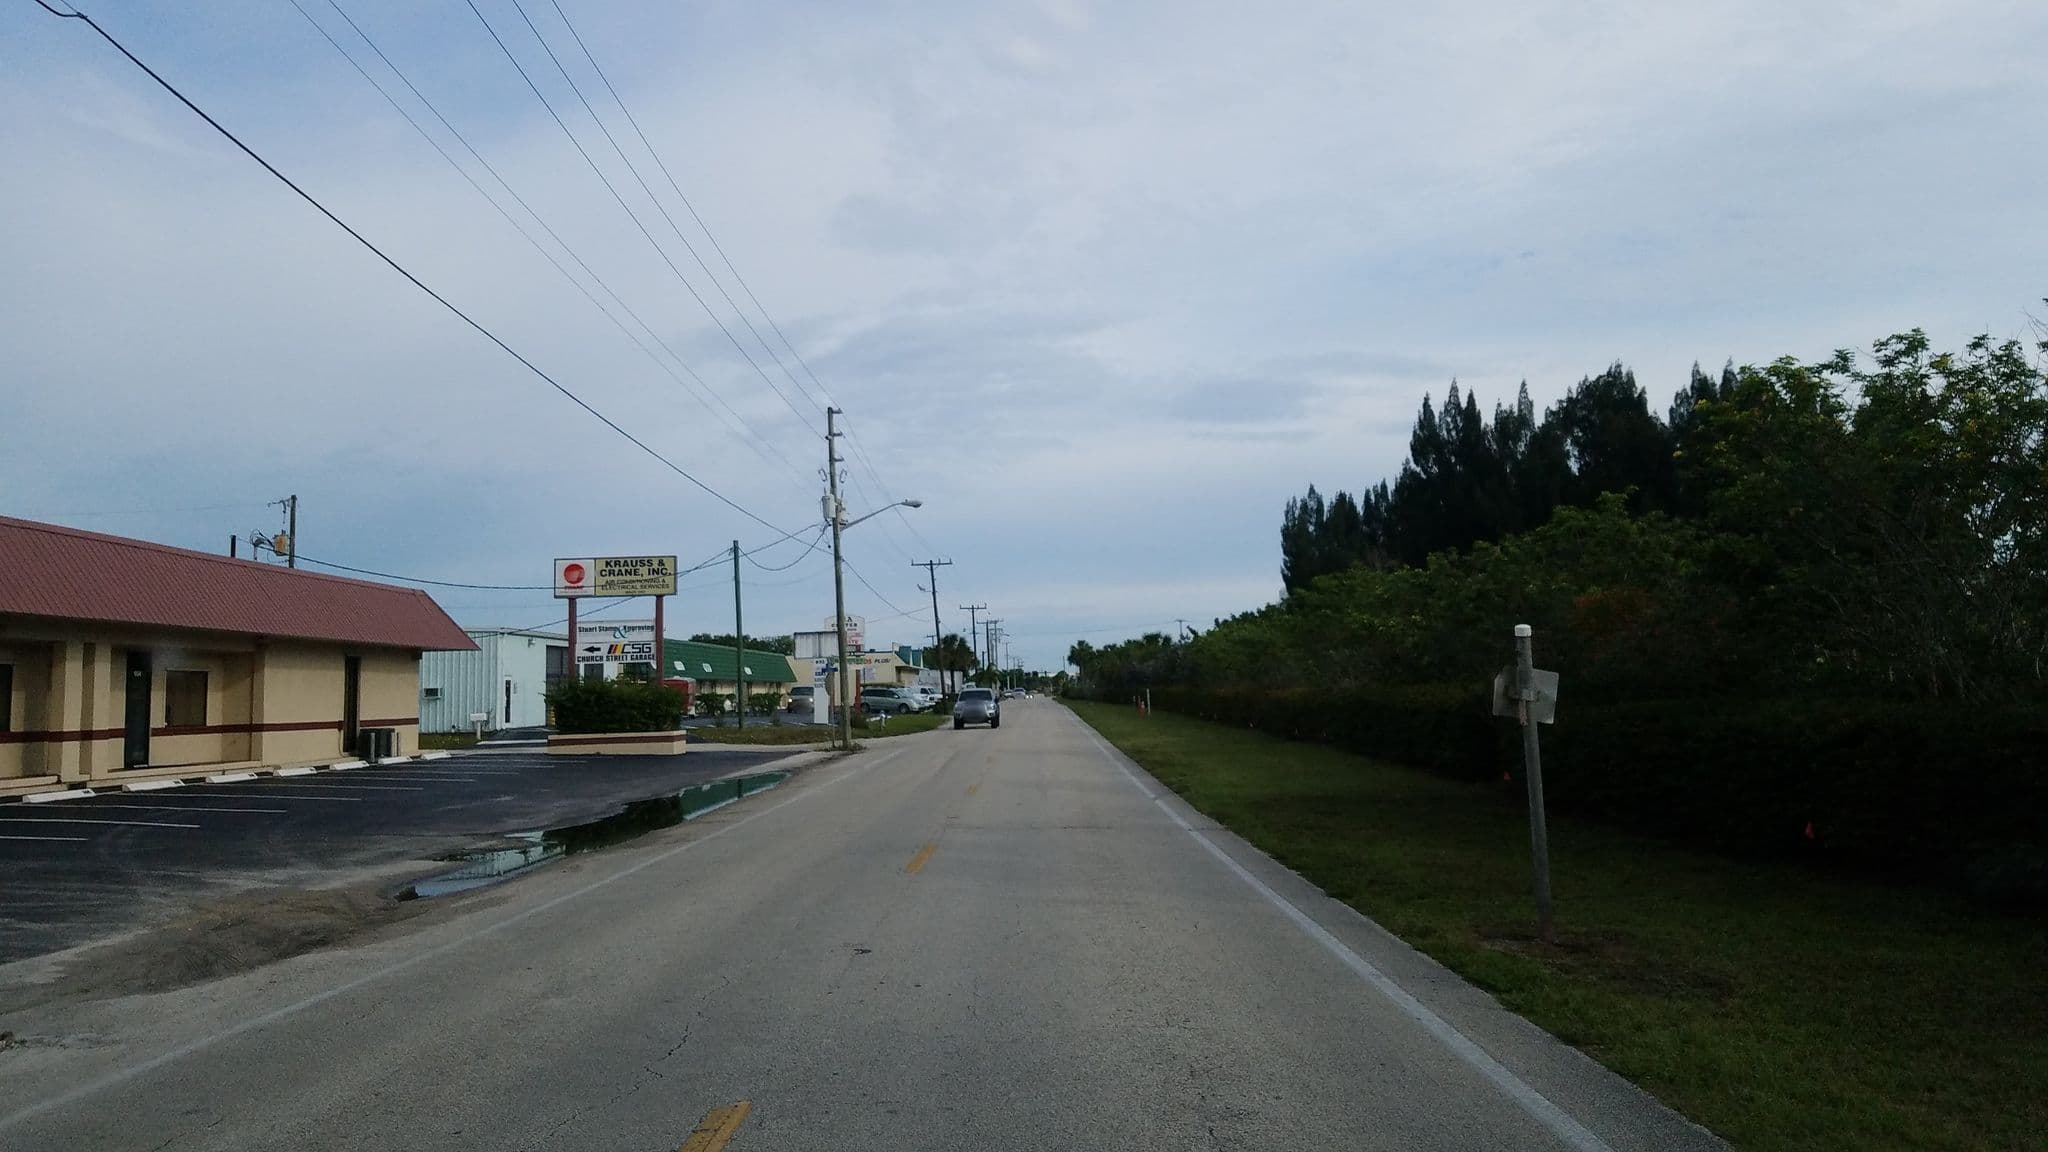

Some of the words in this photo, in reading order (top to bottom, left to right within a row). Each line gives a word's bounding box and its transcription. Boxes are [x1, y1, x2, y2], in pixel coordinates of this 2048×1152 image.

[605, 559, 653, 568] KRAUSS
[658, 559, 665, 567] &
[600, 569, 644, 577] CRANE,
[648, 567, 671, 576] INC.
[621, 643, 652, 654] CSG
